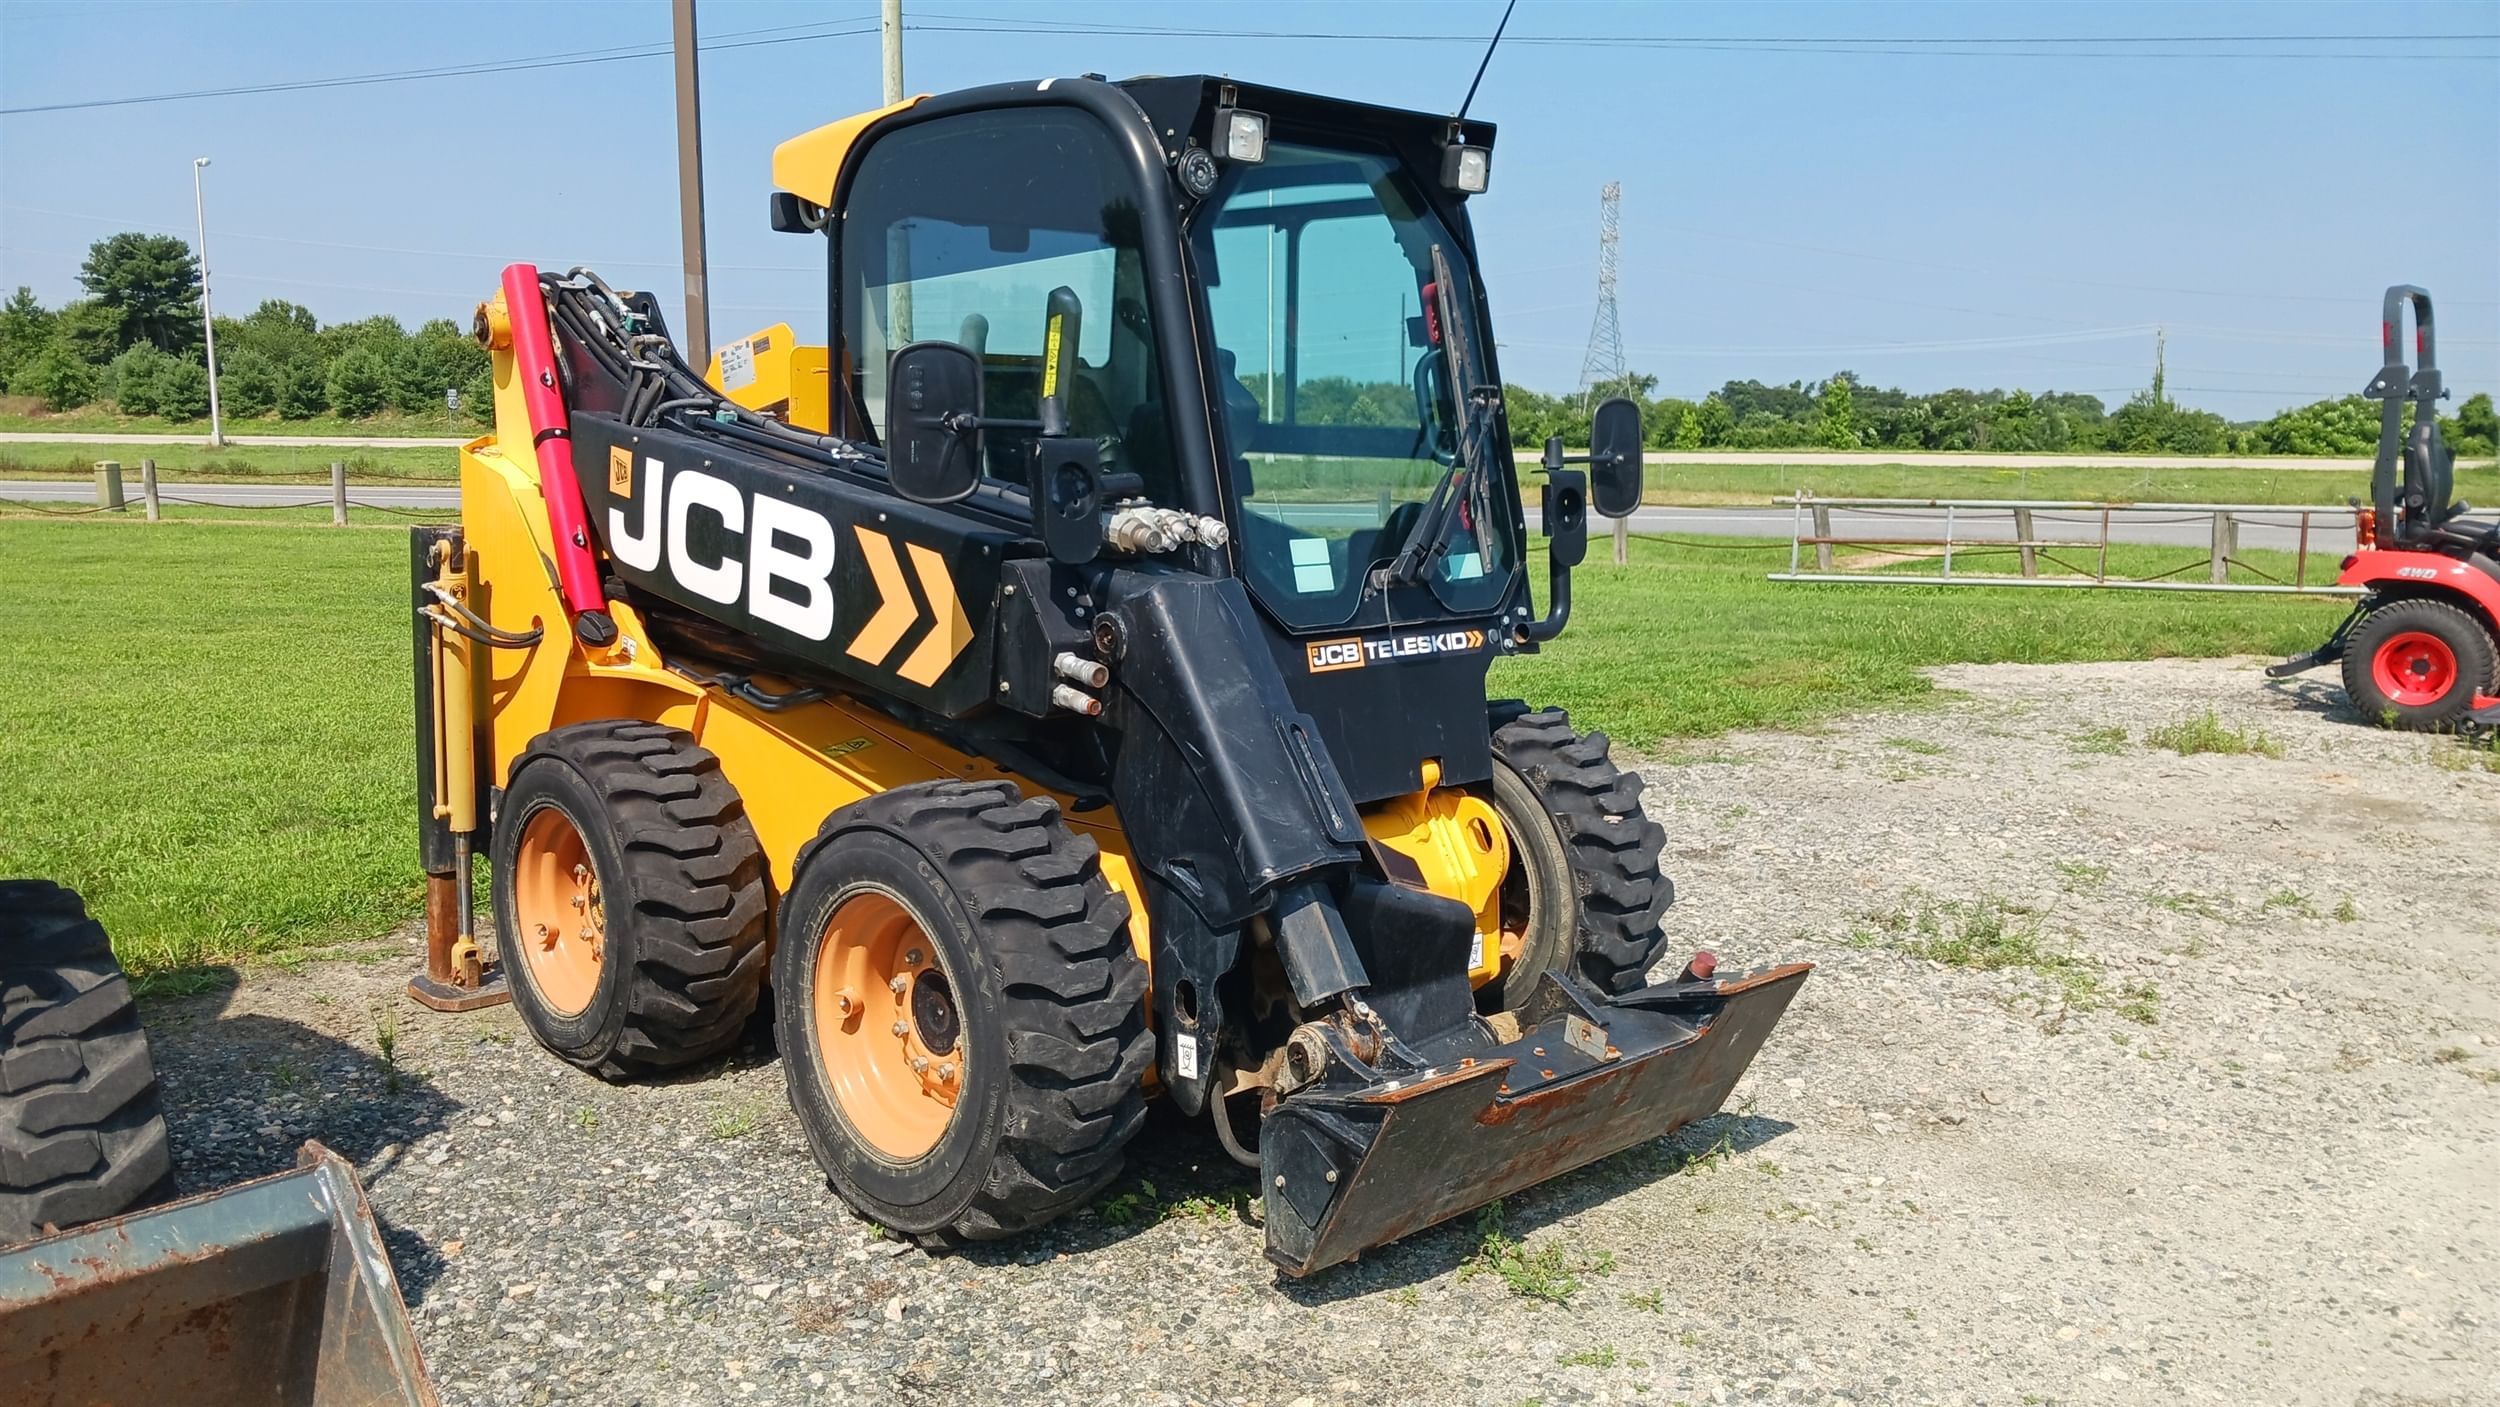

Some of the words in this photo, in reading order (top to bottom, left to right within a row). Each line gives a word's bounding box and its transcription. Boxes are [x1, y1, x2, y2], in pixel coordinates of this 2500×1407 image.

[615, 459, 628, 482] JCB
[609, 457, 835, 641] JCB
[1312, 642, 1361, 667] JCB
[1363, 631, 1468, 660] TELESKID
[916, 860, 993, 999] GALAXY
